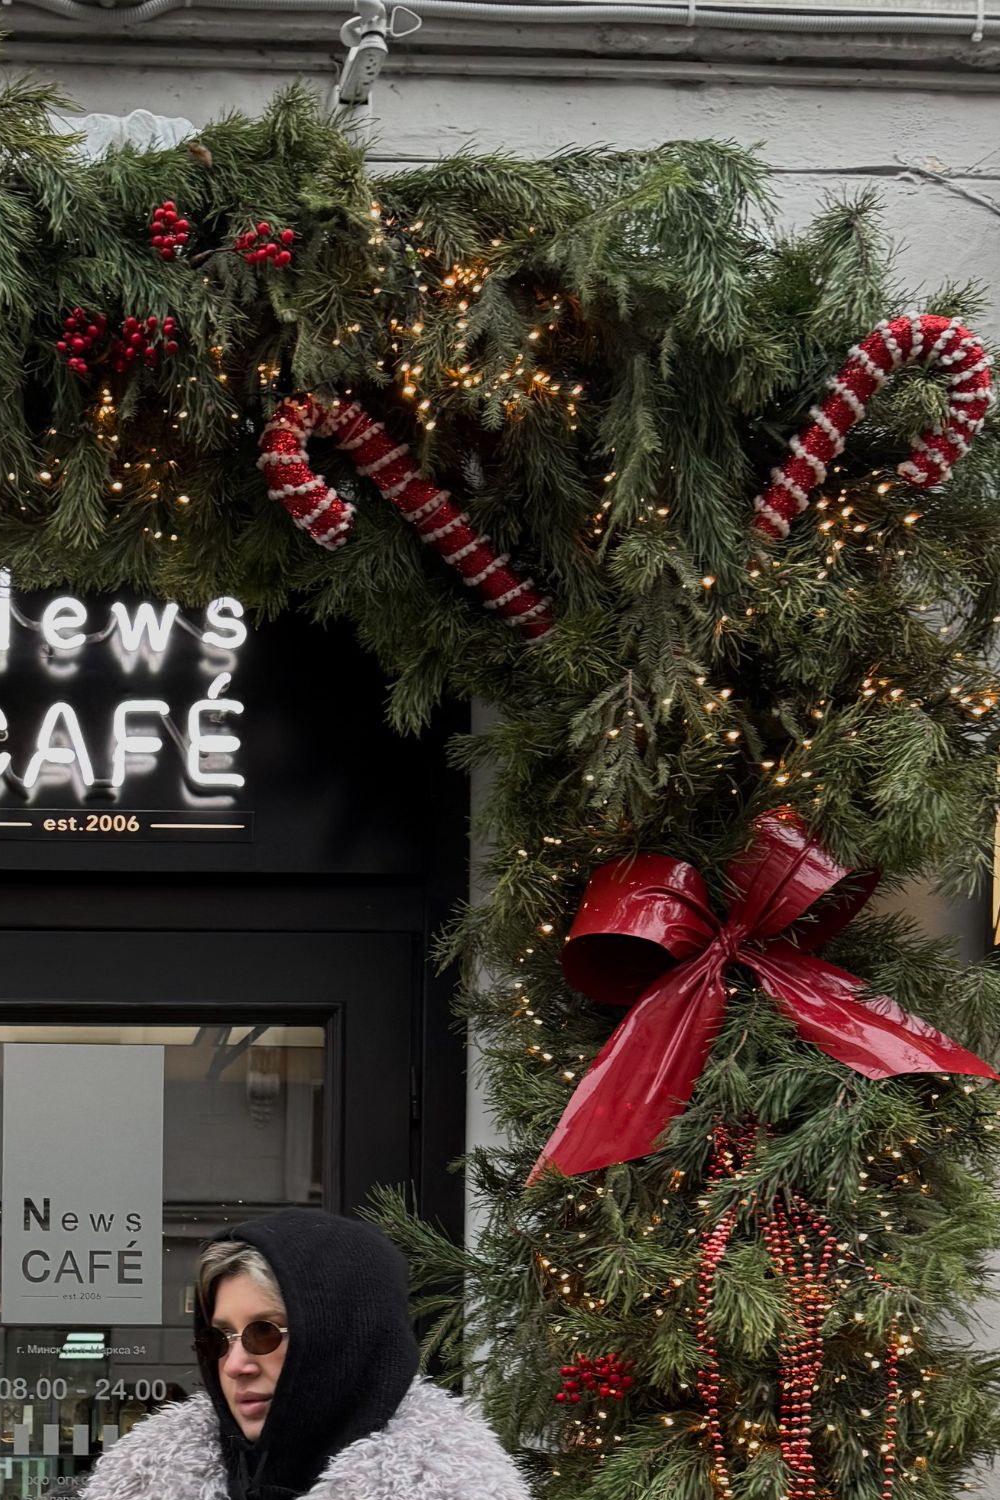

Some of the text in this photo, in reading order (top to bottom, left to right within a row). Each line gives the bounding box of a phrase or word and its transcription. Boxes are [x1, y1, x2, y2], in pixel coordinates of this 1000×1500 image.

[43, 815, 140, 833] est.2006
[23, 1197, 143, 1233] News
[21, 1240, 144, 1285] CAFÉ
[133, 1346, 147, 1355] 34
[95, 1378, 167, 1400] 24.00
